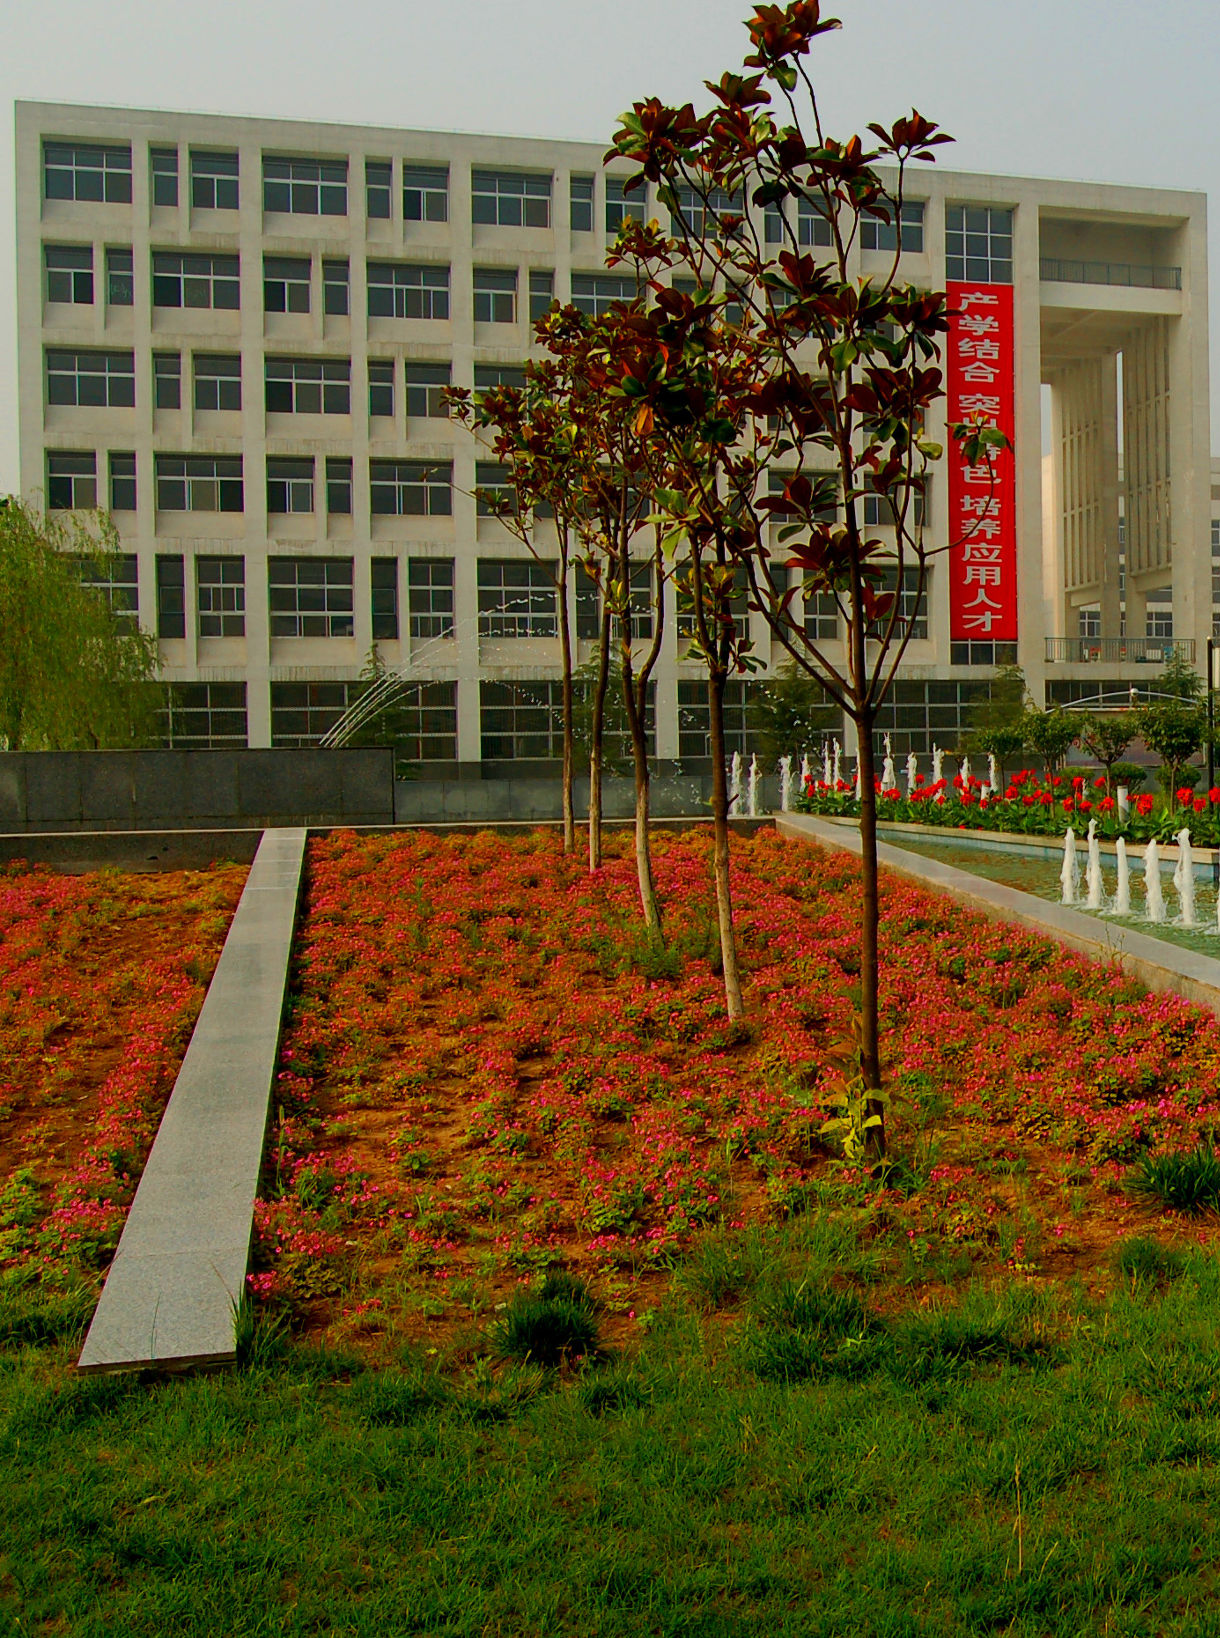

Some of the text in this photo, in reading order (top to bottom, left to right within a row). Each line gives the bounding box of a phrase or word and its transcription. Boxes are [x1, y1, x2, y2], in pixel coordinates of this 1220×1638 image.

[958, 292, 1000, 383] 产学结合
[960, 495, 1003, 632] 培养应用人才
